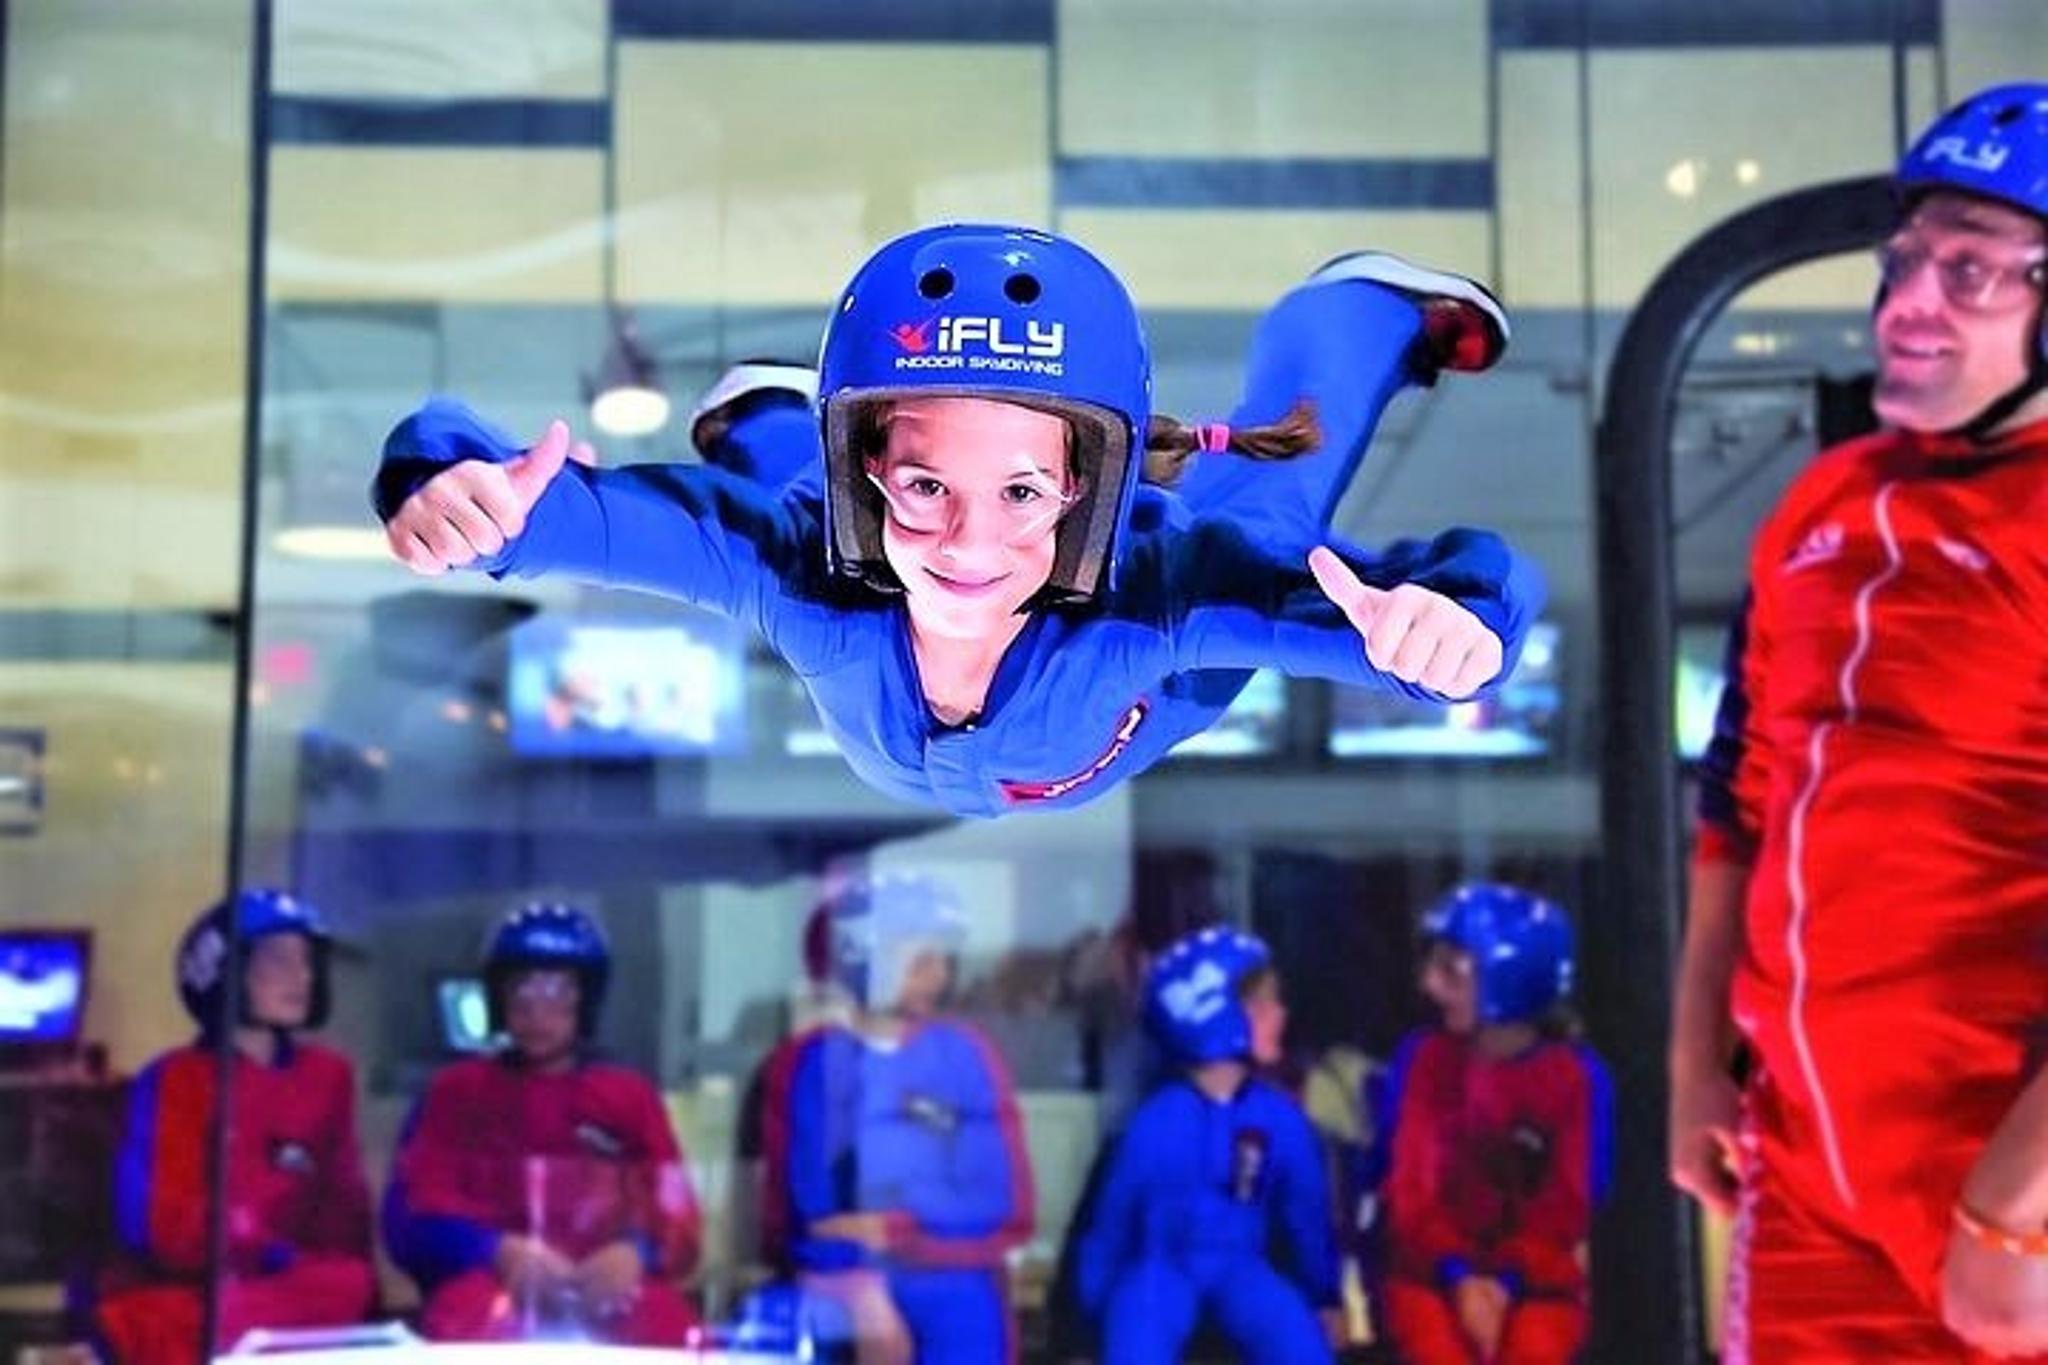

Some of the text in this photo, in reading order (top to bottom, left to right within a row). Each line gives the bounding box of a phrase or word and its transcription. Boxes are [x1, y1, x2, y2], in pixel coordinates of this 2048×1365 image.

[937, 316, 1064, 357] iFLY
[895, 355, 1064, 377] INDOOR SKYDIVING
